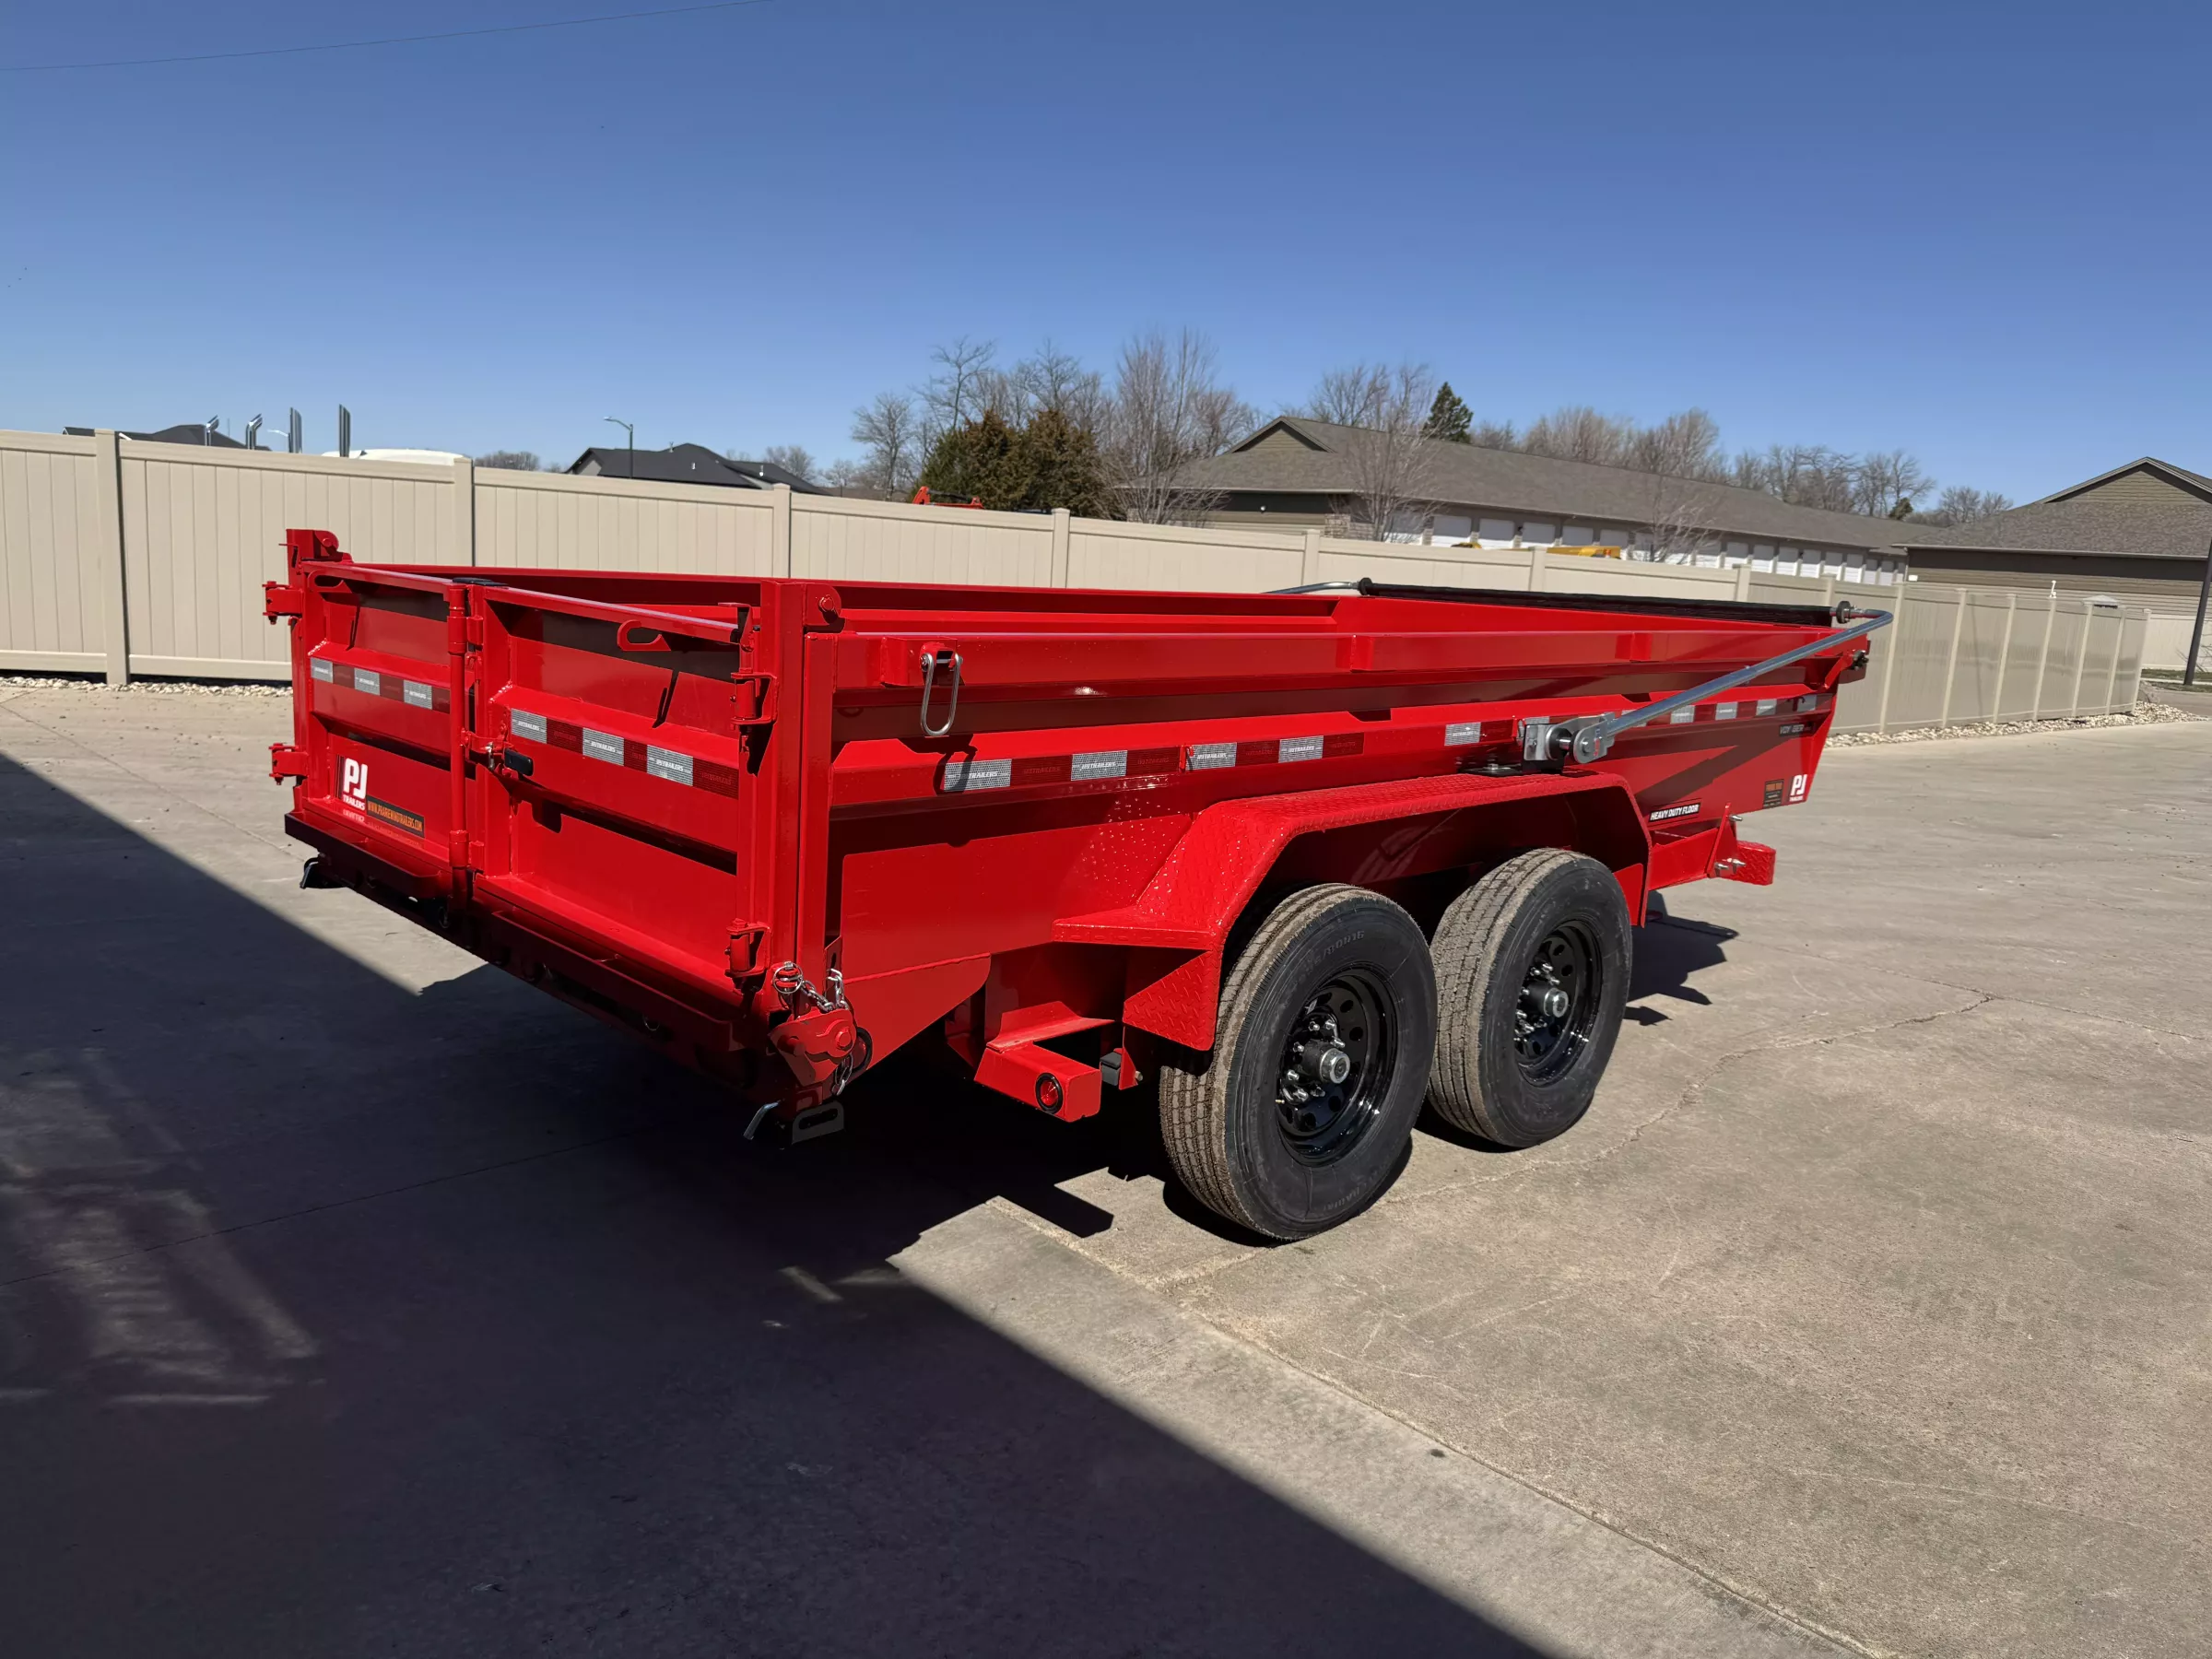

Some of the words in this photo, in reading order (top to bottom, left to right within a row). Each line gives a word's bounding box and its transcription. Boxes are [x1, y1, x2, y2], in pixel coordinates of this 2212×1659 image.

[343, 758, 369, 800] PJ
[1790, 773, 1808, 796] PJ
[342, 794, 366, 811] TRAILERS
[1650, 810, 1668, 821] HEAVY
[1668, 806, 1682, 818] DUTY
[1682, 804, 1700, 815] FLOOR
